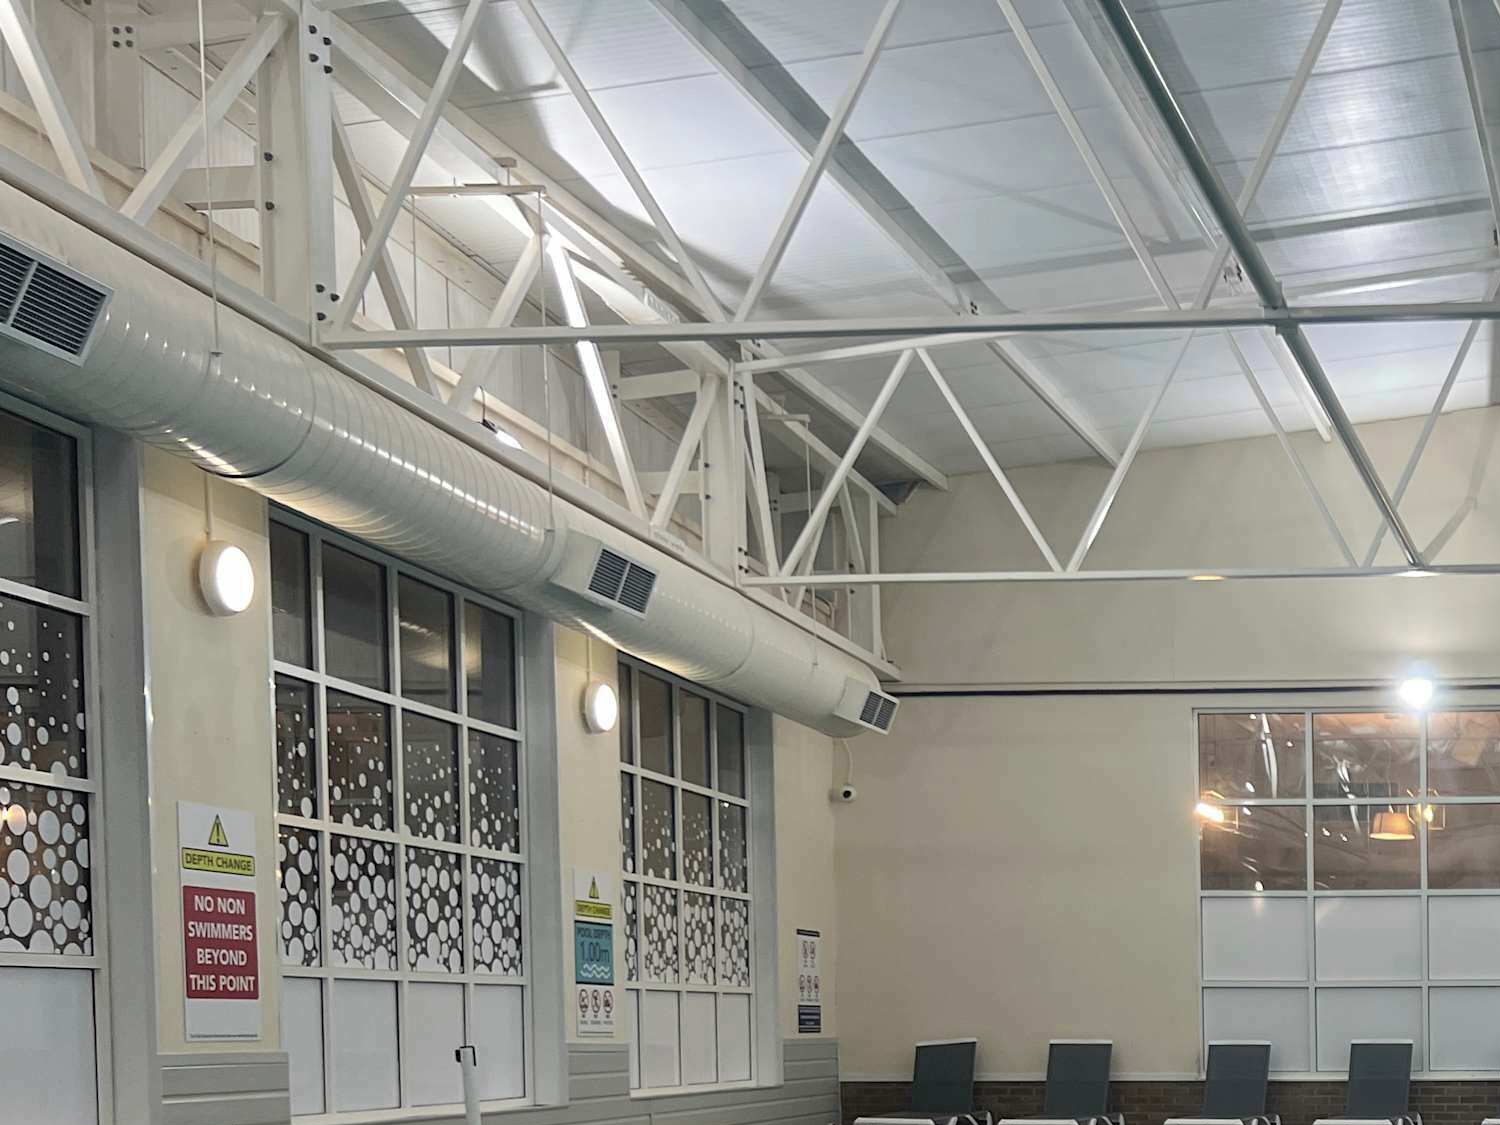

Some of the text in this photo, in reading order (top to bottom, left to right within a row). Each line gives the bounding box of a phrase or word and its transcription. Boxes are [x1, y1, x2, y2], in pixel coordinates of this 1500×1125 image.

[185, 852, 253, 872] DEPTH CHANGE
[194, 895, 246, 915] NO NON
[188, 920, 253, 941] SWIMMERS
[196, 947, 248, 967] BEYOND
[189, 974, 255, 993] THIS POINT
